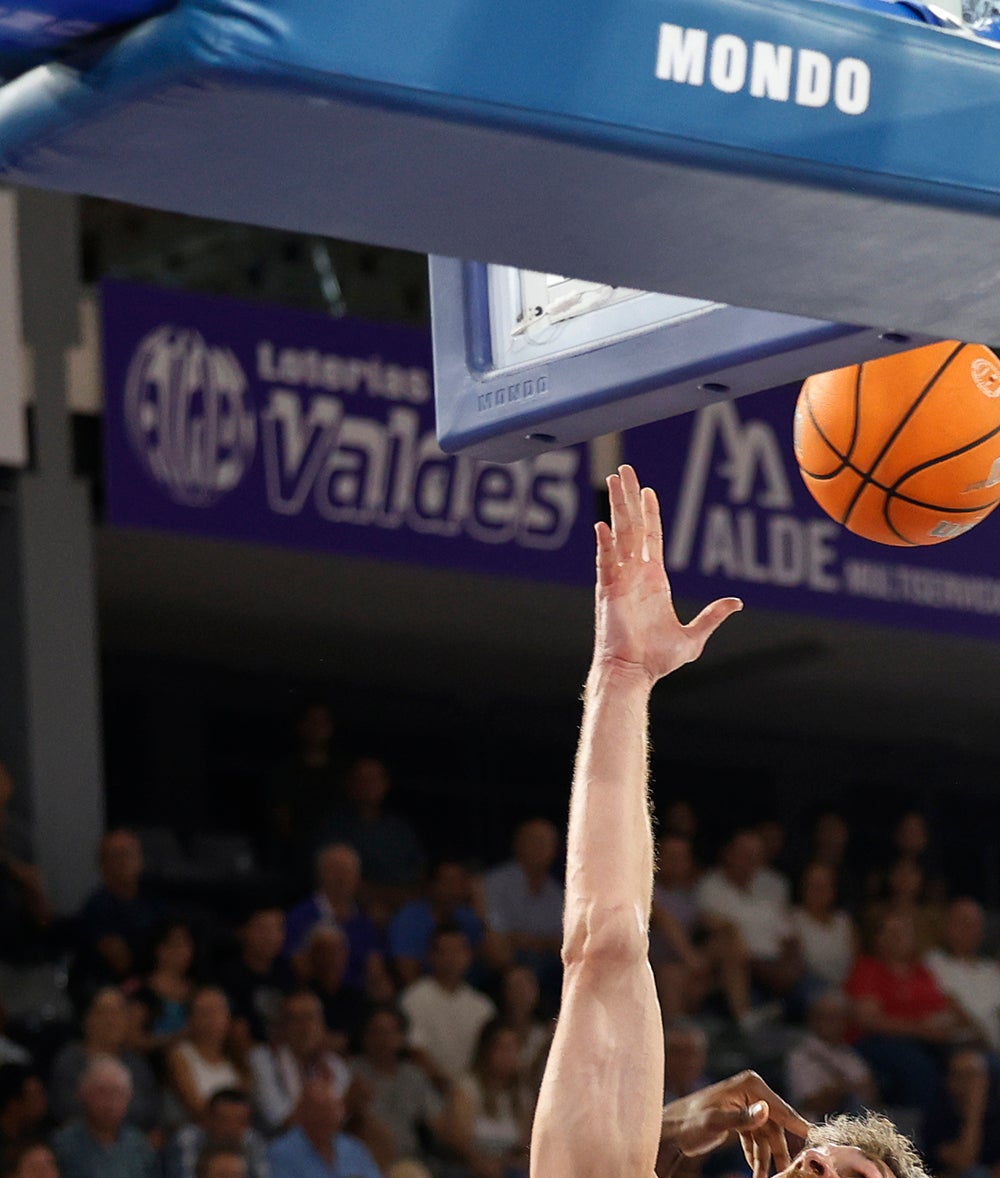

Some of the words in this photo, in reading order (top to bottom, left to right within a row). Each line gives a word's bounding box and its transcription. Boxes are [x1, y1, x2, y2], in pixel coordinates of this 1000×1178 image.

[655, 22, 872, 116] MONDO
[477, 375, 549, 413] MONDO
[703, 504, 841, 594] ALDE
